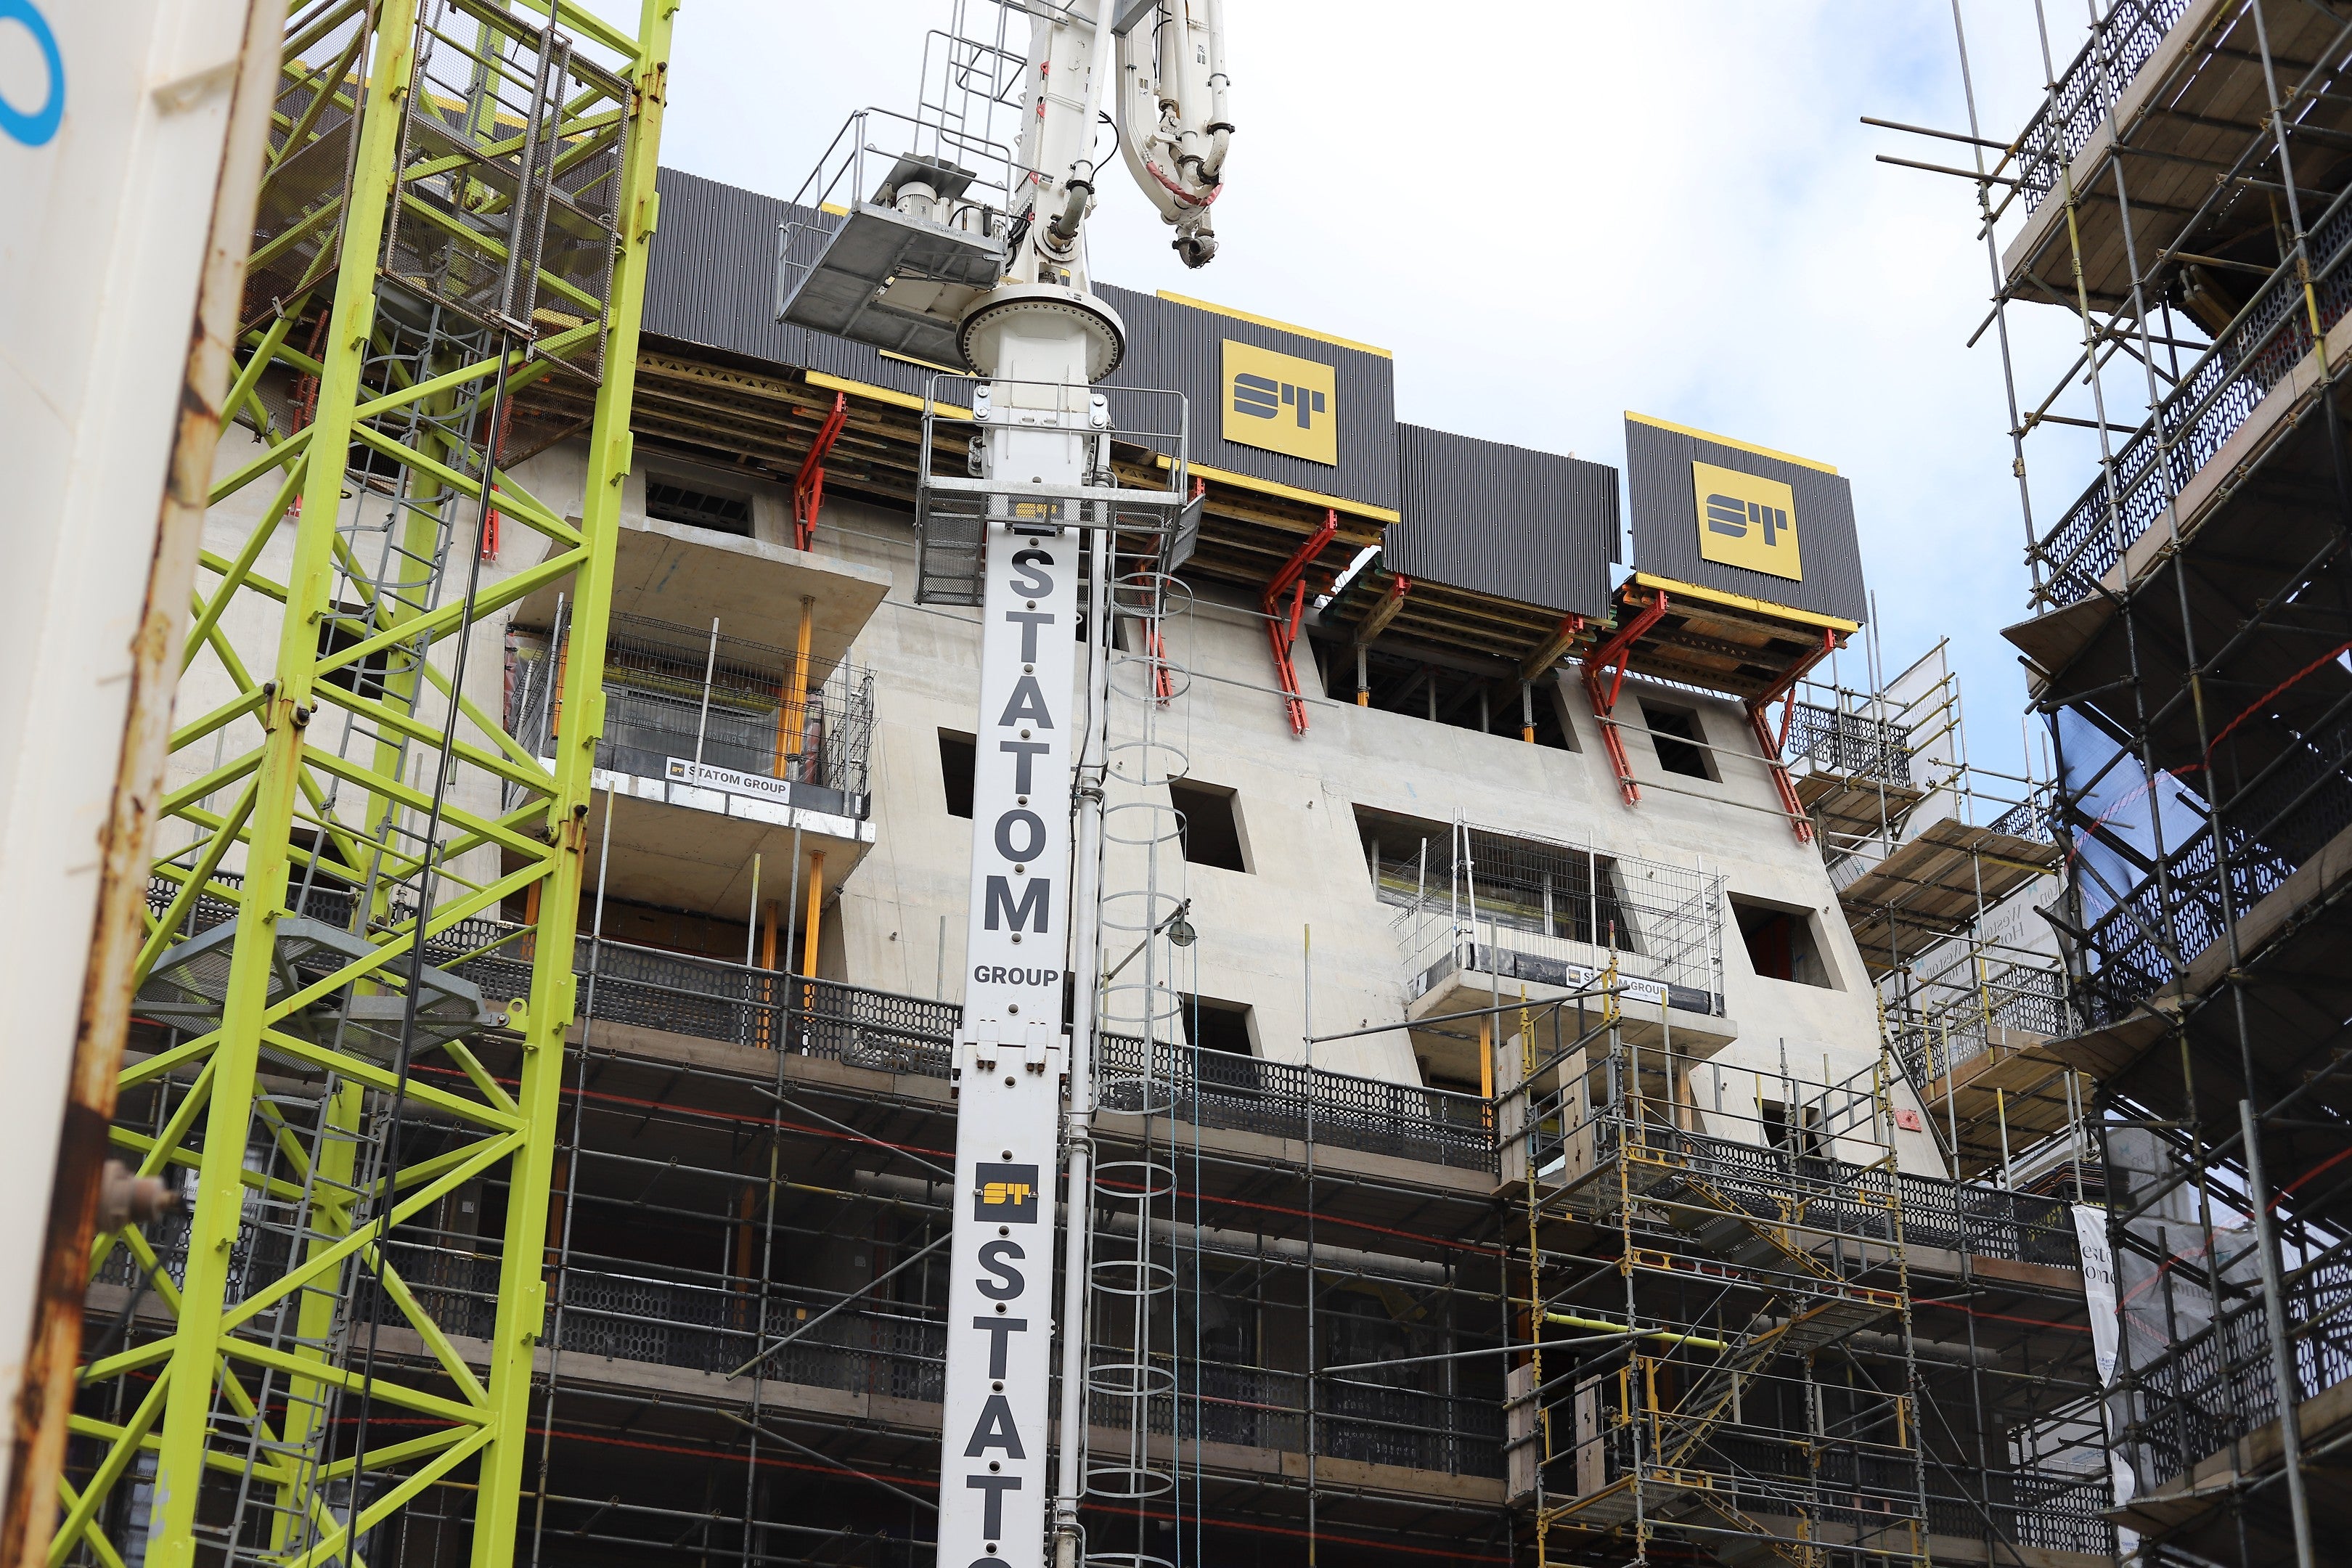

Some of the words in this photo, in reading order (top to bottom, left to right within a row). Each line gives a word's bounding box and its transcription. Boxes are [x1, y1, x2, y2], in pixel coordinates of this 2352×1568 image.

[1233, 372, 1326, 429] ST
[1706, 493, 1788, 547] ST
[984, 549, 1055, 934] STATOM
[688, 766, 740, 785] STATOM
[743, 777, 786, 794] GROUP
[974, 965, 1059, 987] GROUP
[983, 1182, 1031, 1205] ST
[963, 1240, 1028, 1568] STAT
